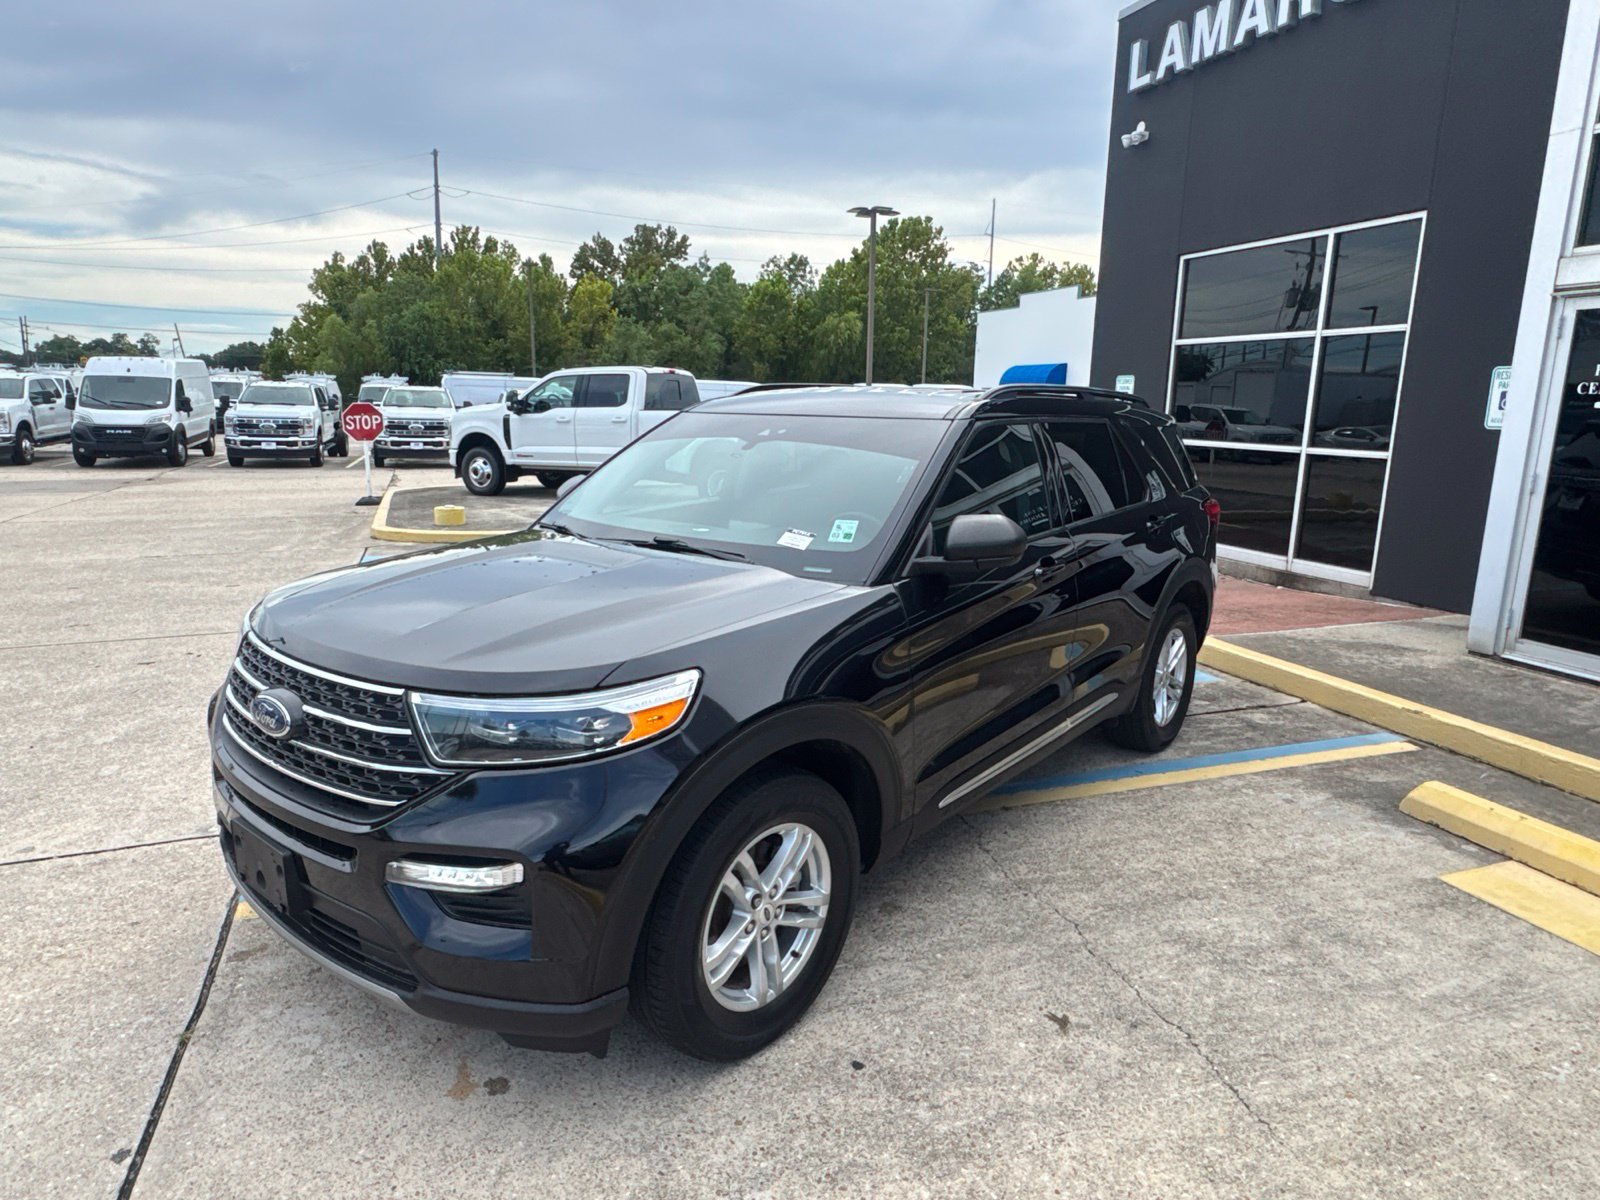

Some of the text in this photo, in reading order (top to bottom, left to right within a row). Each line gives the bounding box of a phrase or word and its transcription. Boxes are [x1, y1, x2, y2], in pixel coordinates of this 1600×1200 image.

[1128, 0, 1347, 93] LAMA
[1576, 381, 1600, 395] CE
[345, 415, 381, 430] STOP
[255, 702, 279, 729] Ford
